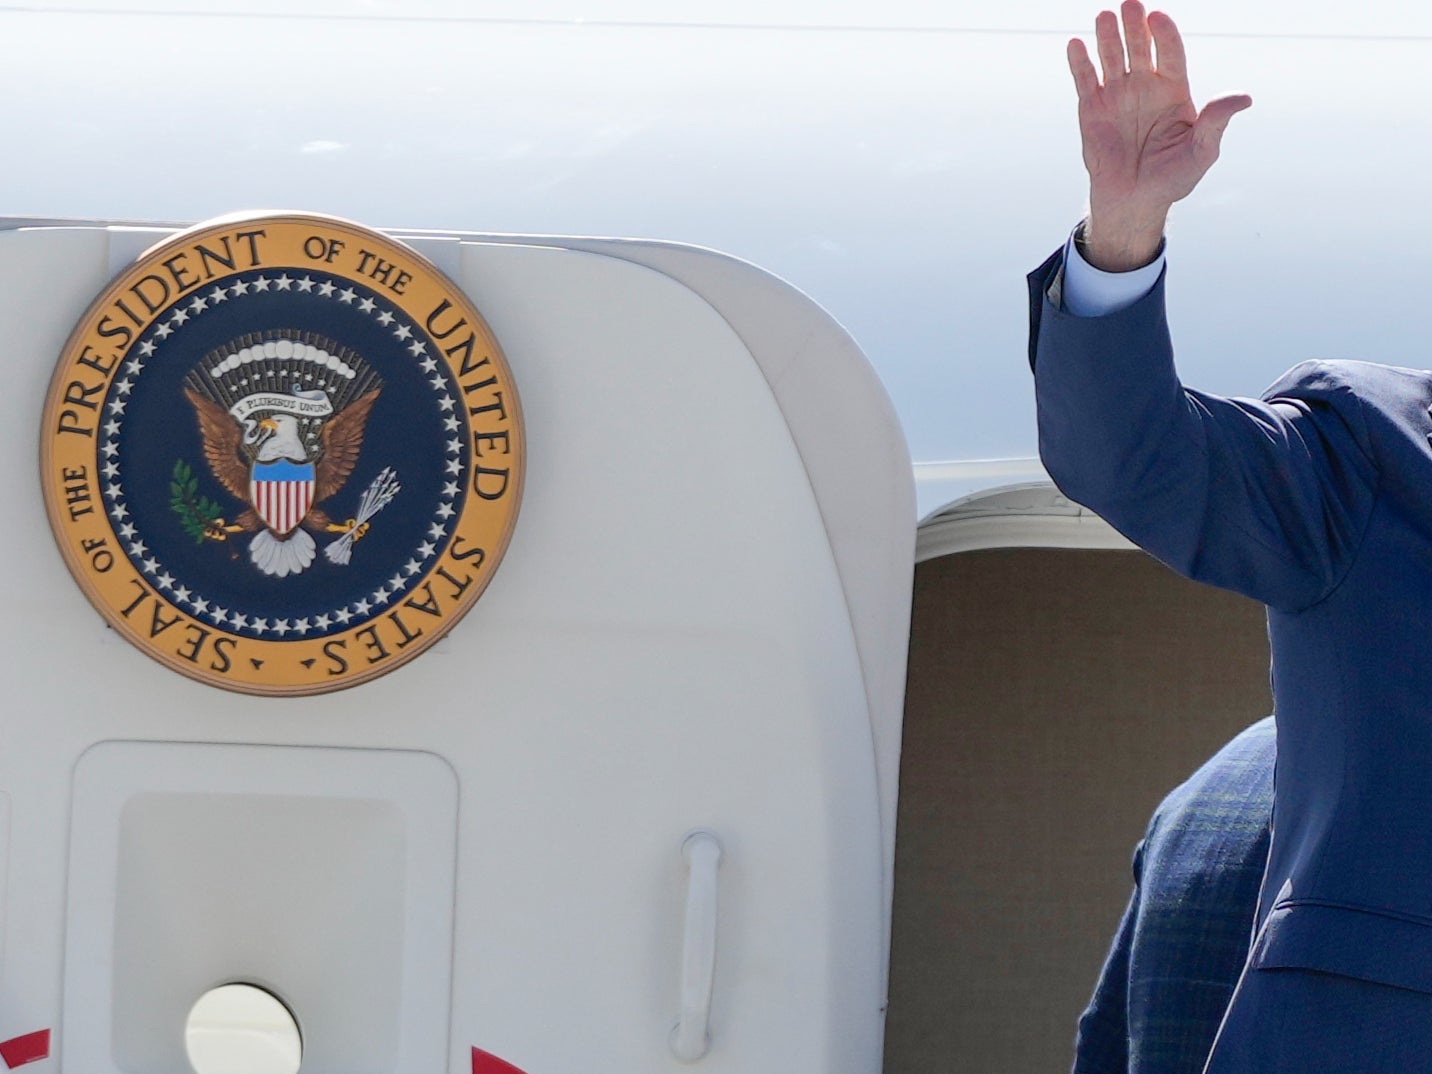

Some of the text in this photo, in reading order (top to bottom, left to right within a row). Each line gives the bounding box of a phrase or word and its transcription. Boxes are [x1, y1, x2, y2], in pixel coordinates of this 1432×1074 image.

[57, 229, 511, 675] SEAL OF THE PRESIDENT OF THE UNITED STATES
